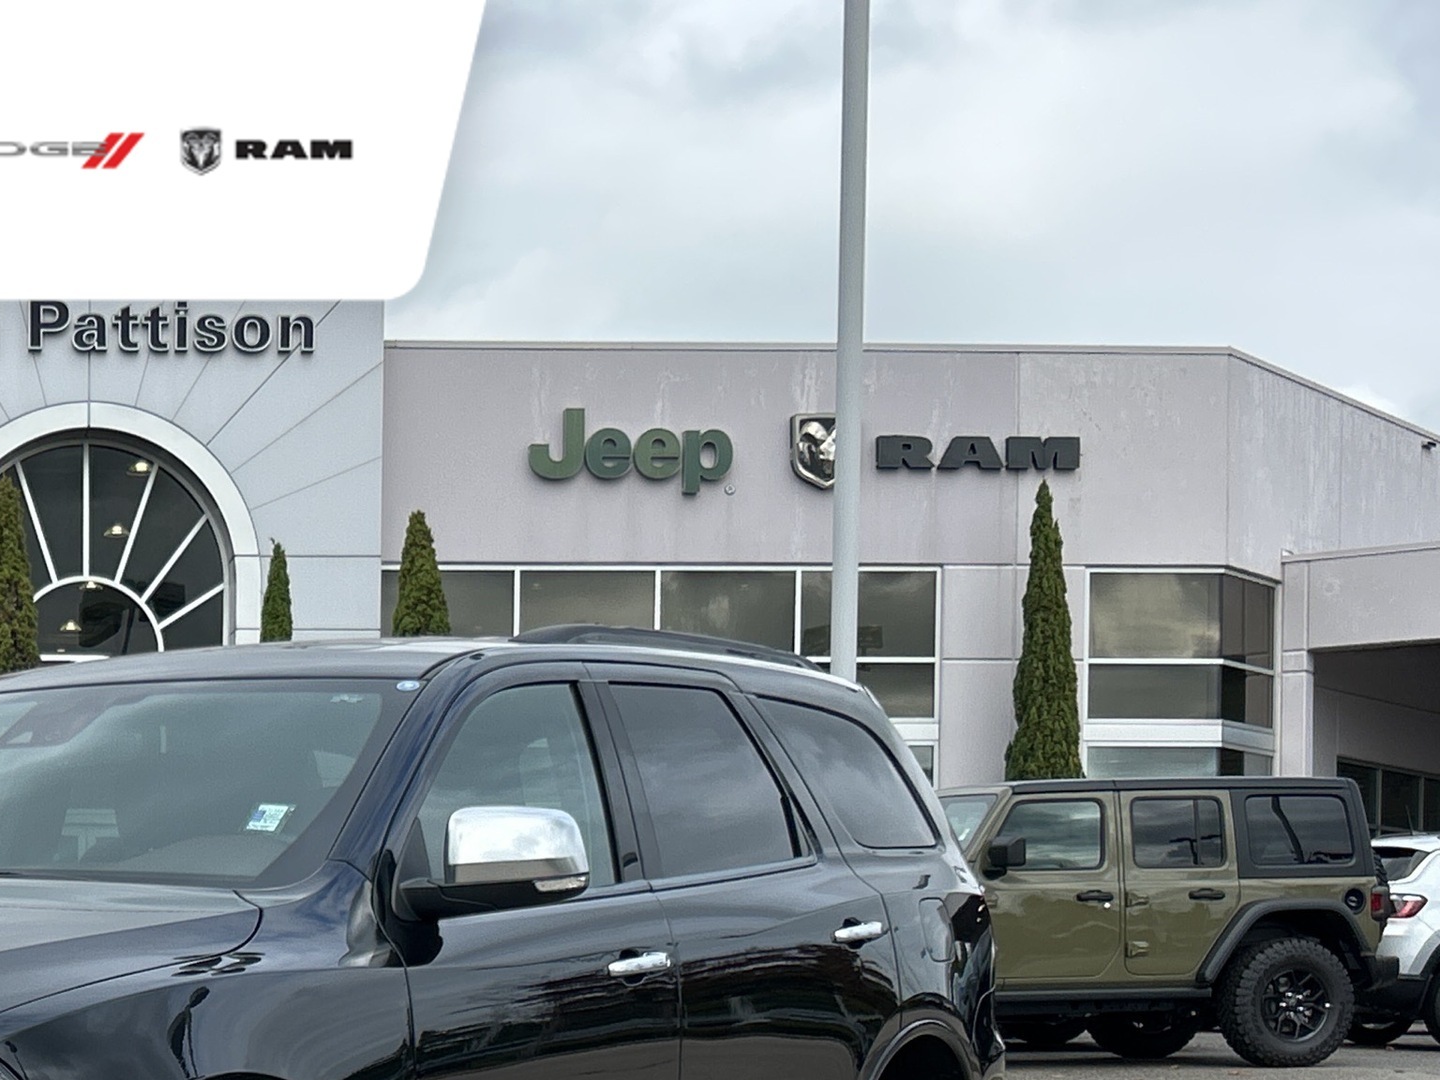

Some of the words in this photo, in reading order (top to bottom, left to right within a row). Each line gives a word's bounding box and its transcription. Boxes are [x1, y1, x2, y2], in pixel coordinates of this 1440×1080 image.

[27, 300, 316, 353] Pattison
[527, 408, 734, 495] Jeep
[875, 435, 1081, 470] RAM
